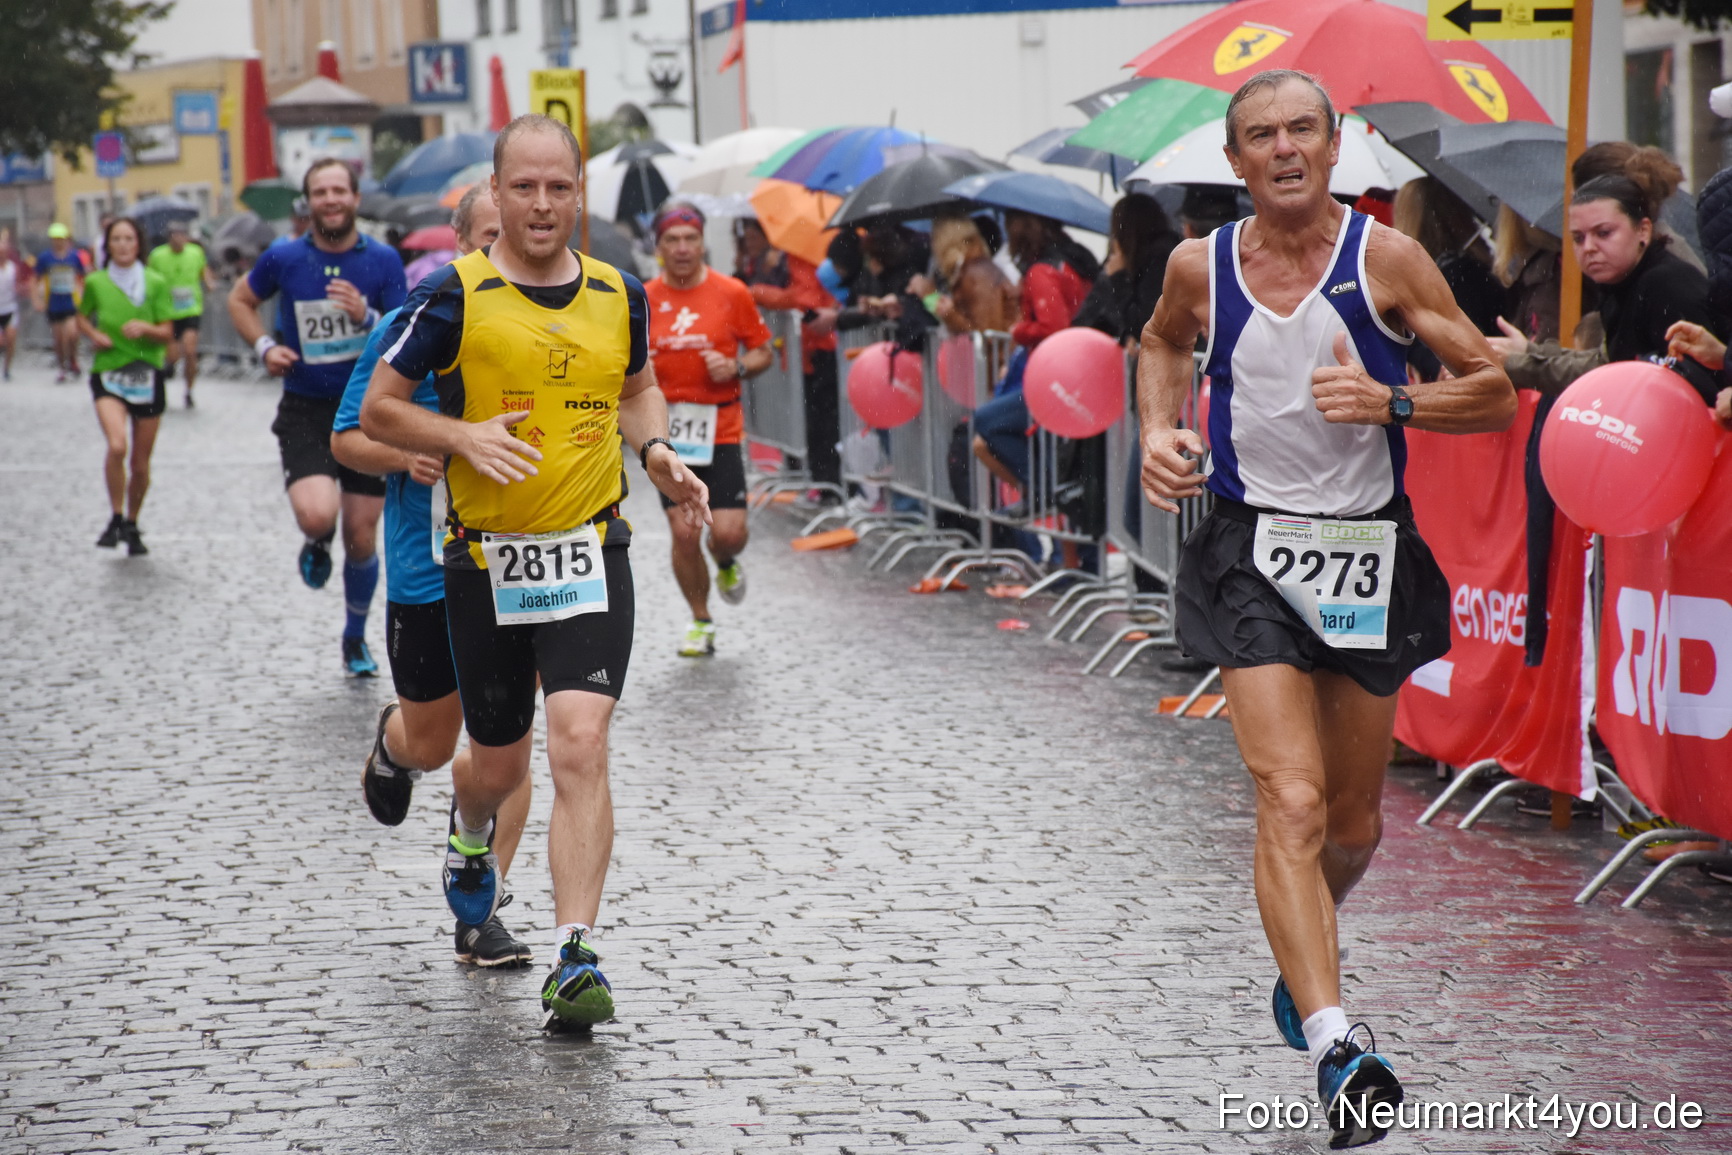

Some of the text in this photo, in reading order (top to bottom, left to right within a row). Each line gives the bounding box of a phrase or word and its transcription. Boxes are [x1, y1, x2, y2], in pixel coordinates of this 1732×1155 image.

[305, 314, 363, 339] 291
[501, 397, 535, 411] Seidl
[1596, 430, 1639, 455] energie
[1268, 529, 1312, 540] NeuerMarkt
[1321, 523, 1385, 541] BOCK
[498, 540, 593, 582] 2815
[1269, 546, 1380, 598] 2273
[519, 590, 578, 609] Joachim
[587, 675, 610, 686] adidas
